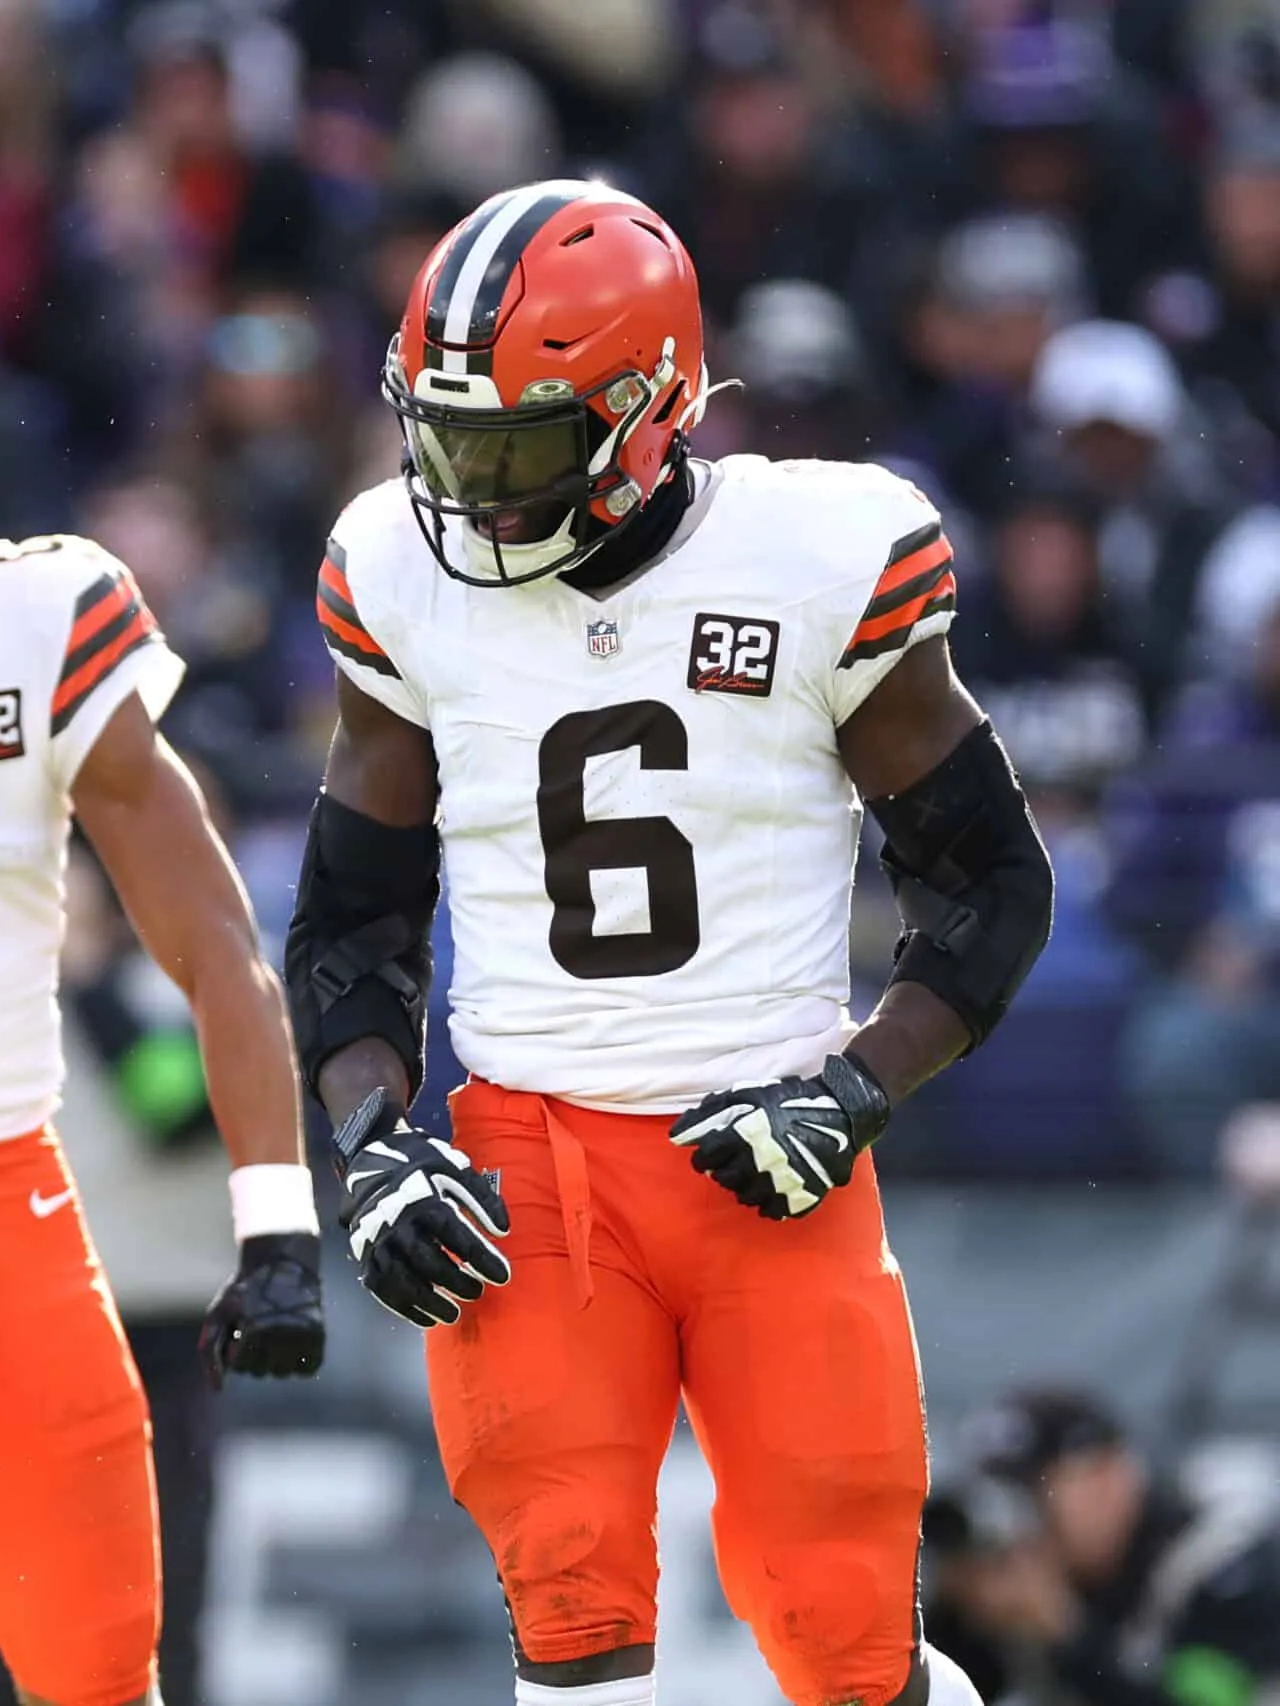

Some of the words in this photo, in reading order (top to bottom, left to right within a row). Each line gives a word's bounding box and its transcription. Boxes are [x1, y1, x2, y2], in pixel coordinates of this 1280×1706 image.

[592, 636, 616, 653] NFL
[696, 621, 771, 679] 32
[537, 700, 700, 979] 6
